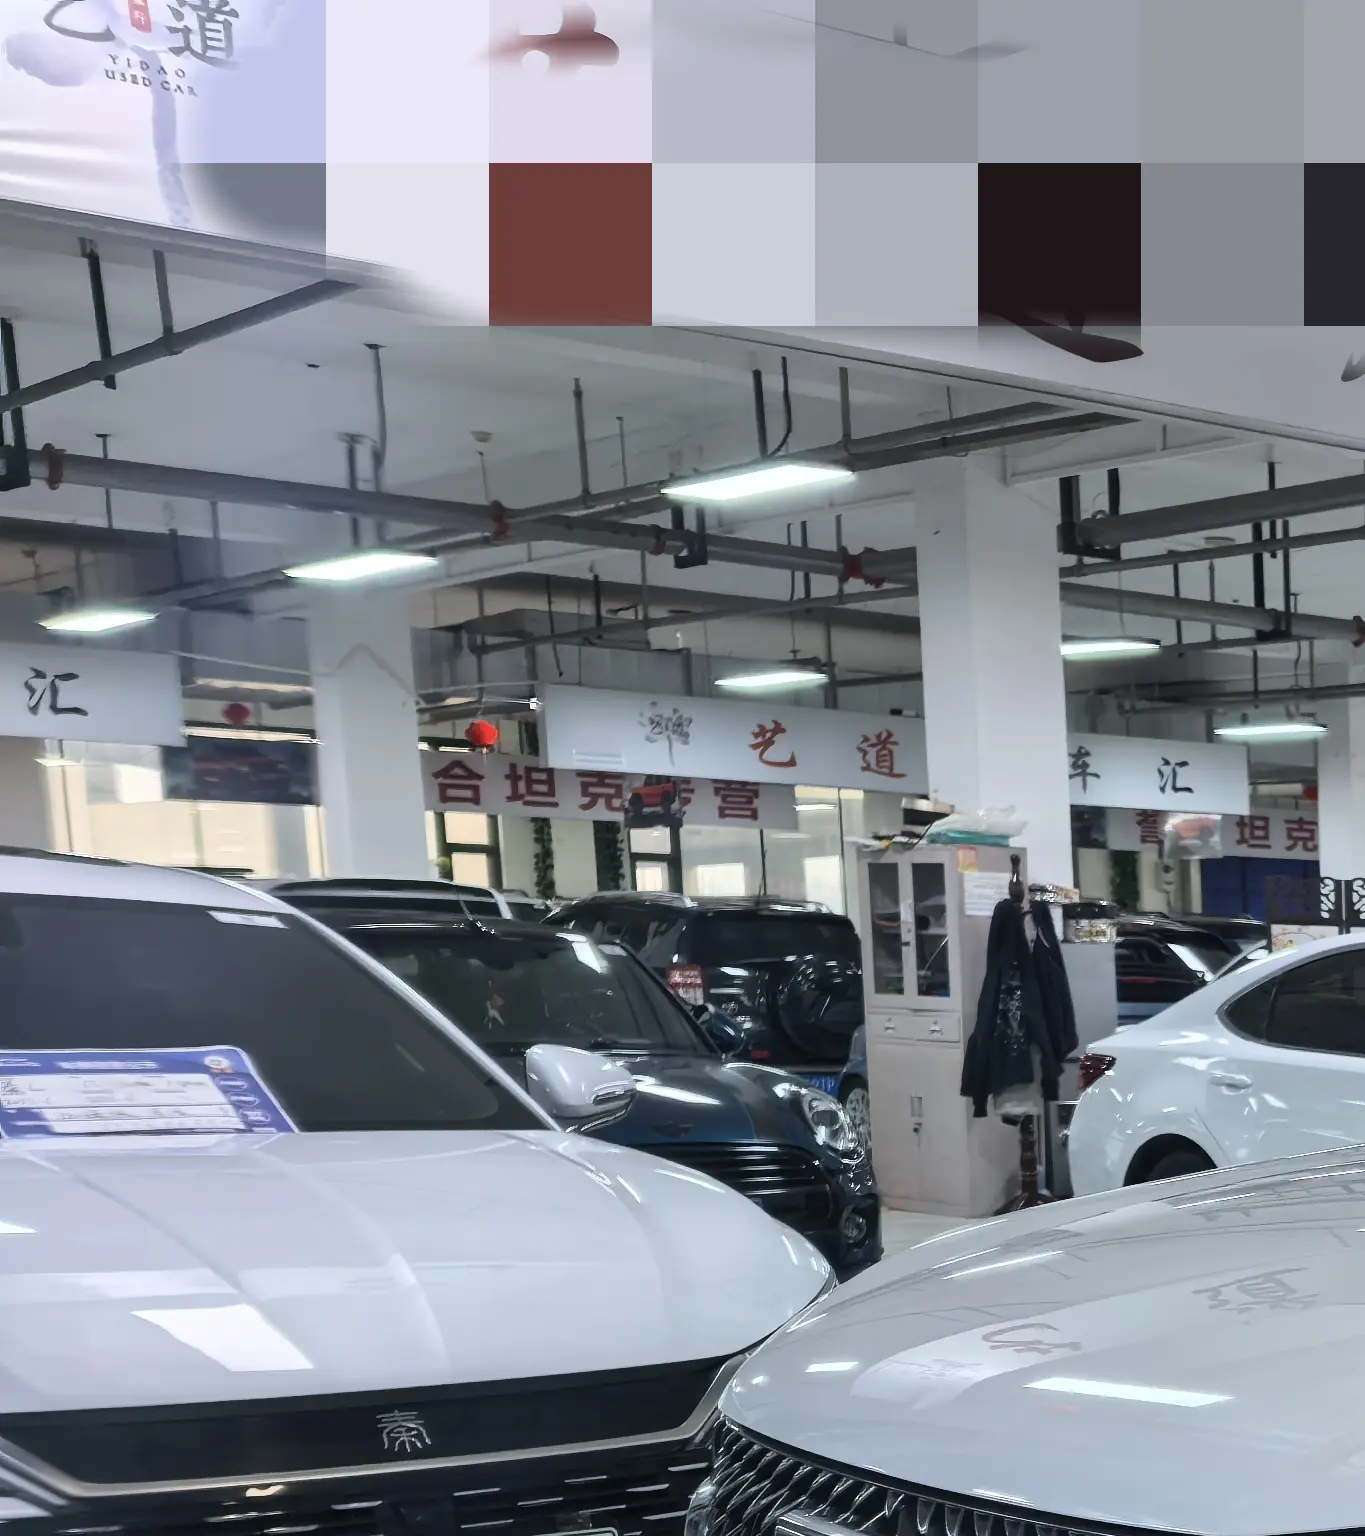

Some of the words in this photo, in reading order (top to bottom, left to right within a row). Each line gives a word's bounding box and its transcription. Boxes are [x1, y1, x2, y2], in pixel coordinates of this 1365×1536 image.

[105, 53, 188, 79] YIDAO
[160, 79, 199, 98] CAR
[24, 666, 89, 717] 汇
